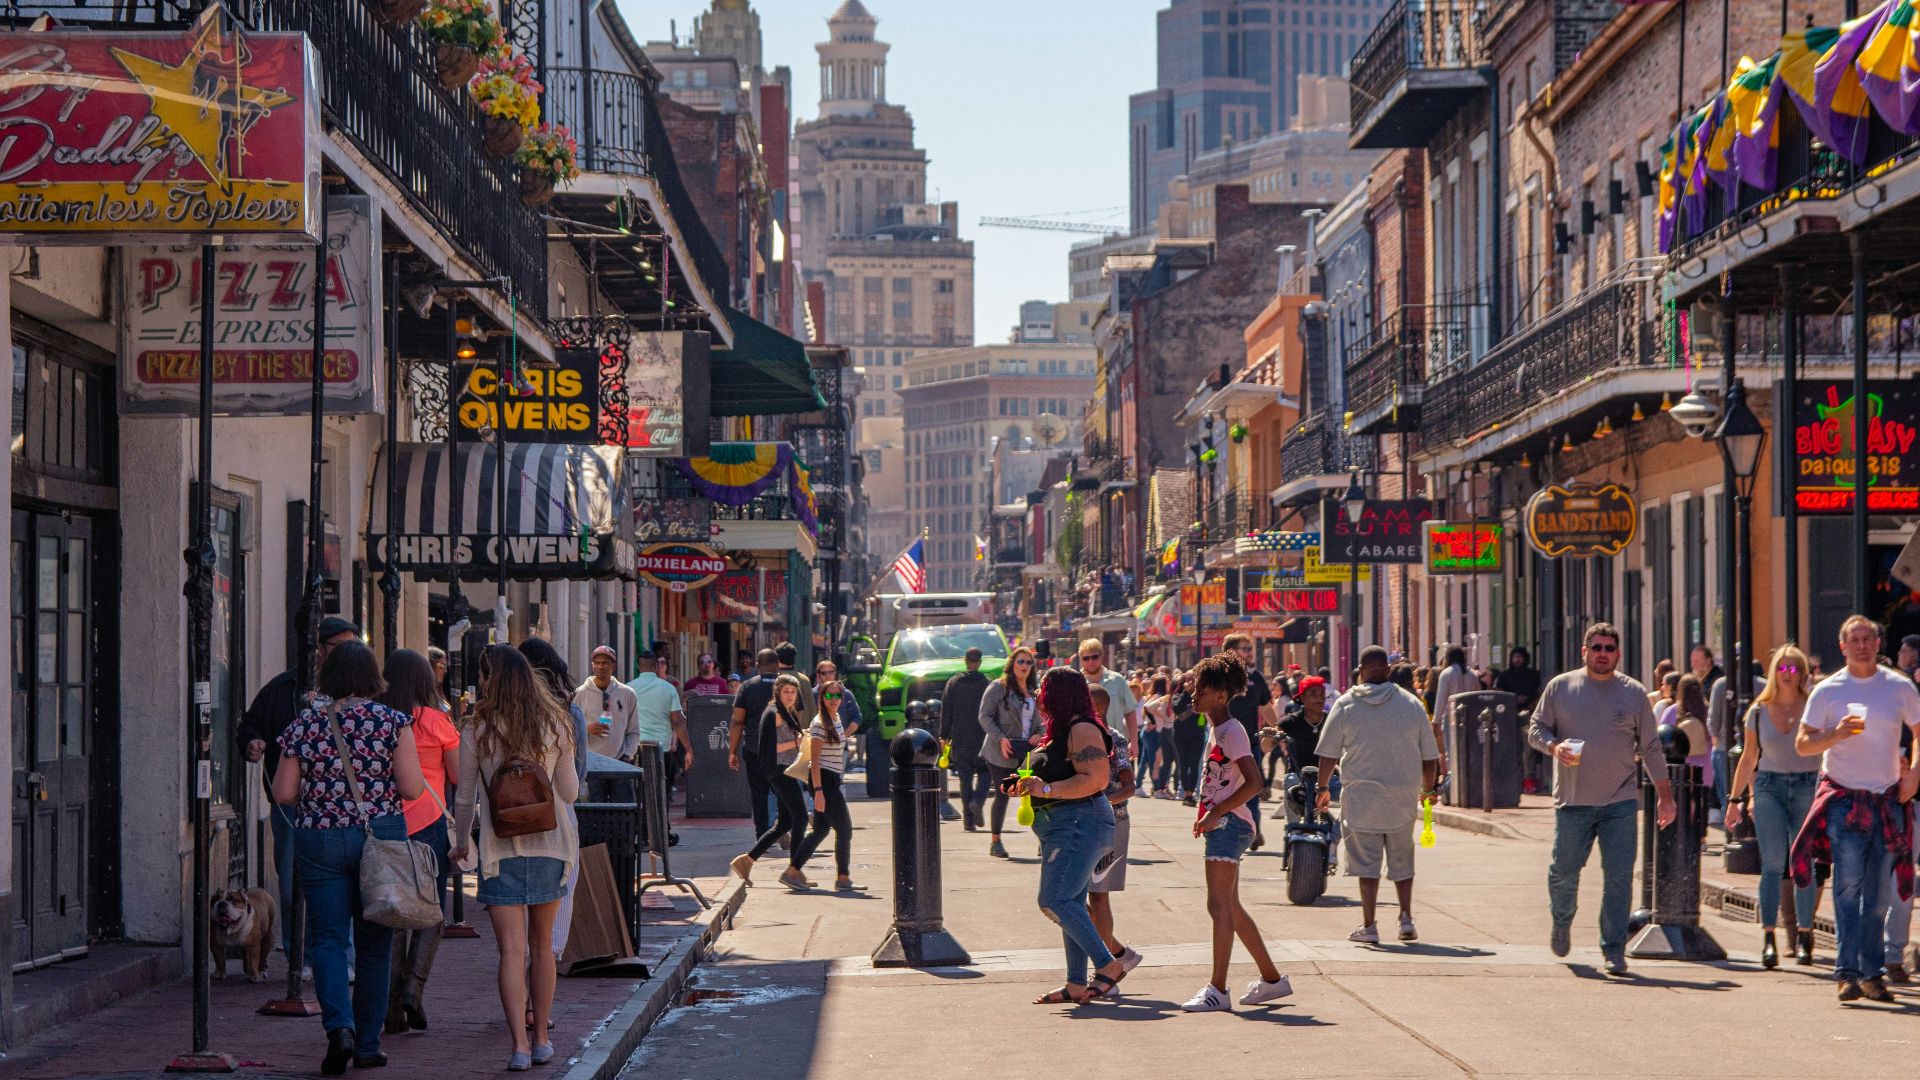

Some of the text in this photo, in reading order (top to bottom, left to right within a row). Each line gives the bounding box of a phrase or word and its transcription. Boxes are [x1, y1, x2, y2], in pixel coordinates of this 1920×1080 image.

[165, 188, 297, 228] Topless
[213, 354, 240, 378] BY
[247, 354, 286, 378] THE
[291, 354, 350, 379] SLCE
[650, 428, 679, 444] Club
[1795, 416, 1842, 455] BIG
[1536, 511, 1632, 533] BANDSTAND
[486, 537, 601, 564] OWENS
[637, 557, 725, 572] DIXIELAND
[1284, 590, 1312, 611] LEGAL
[1314, 590, 1337, 611] CLUB
